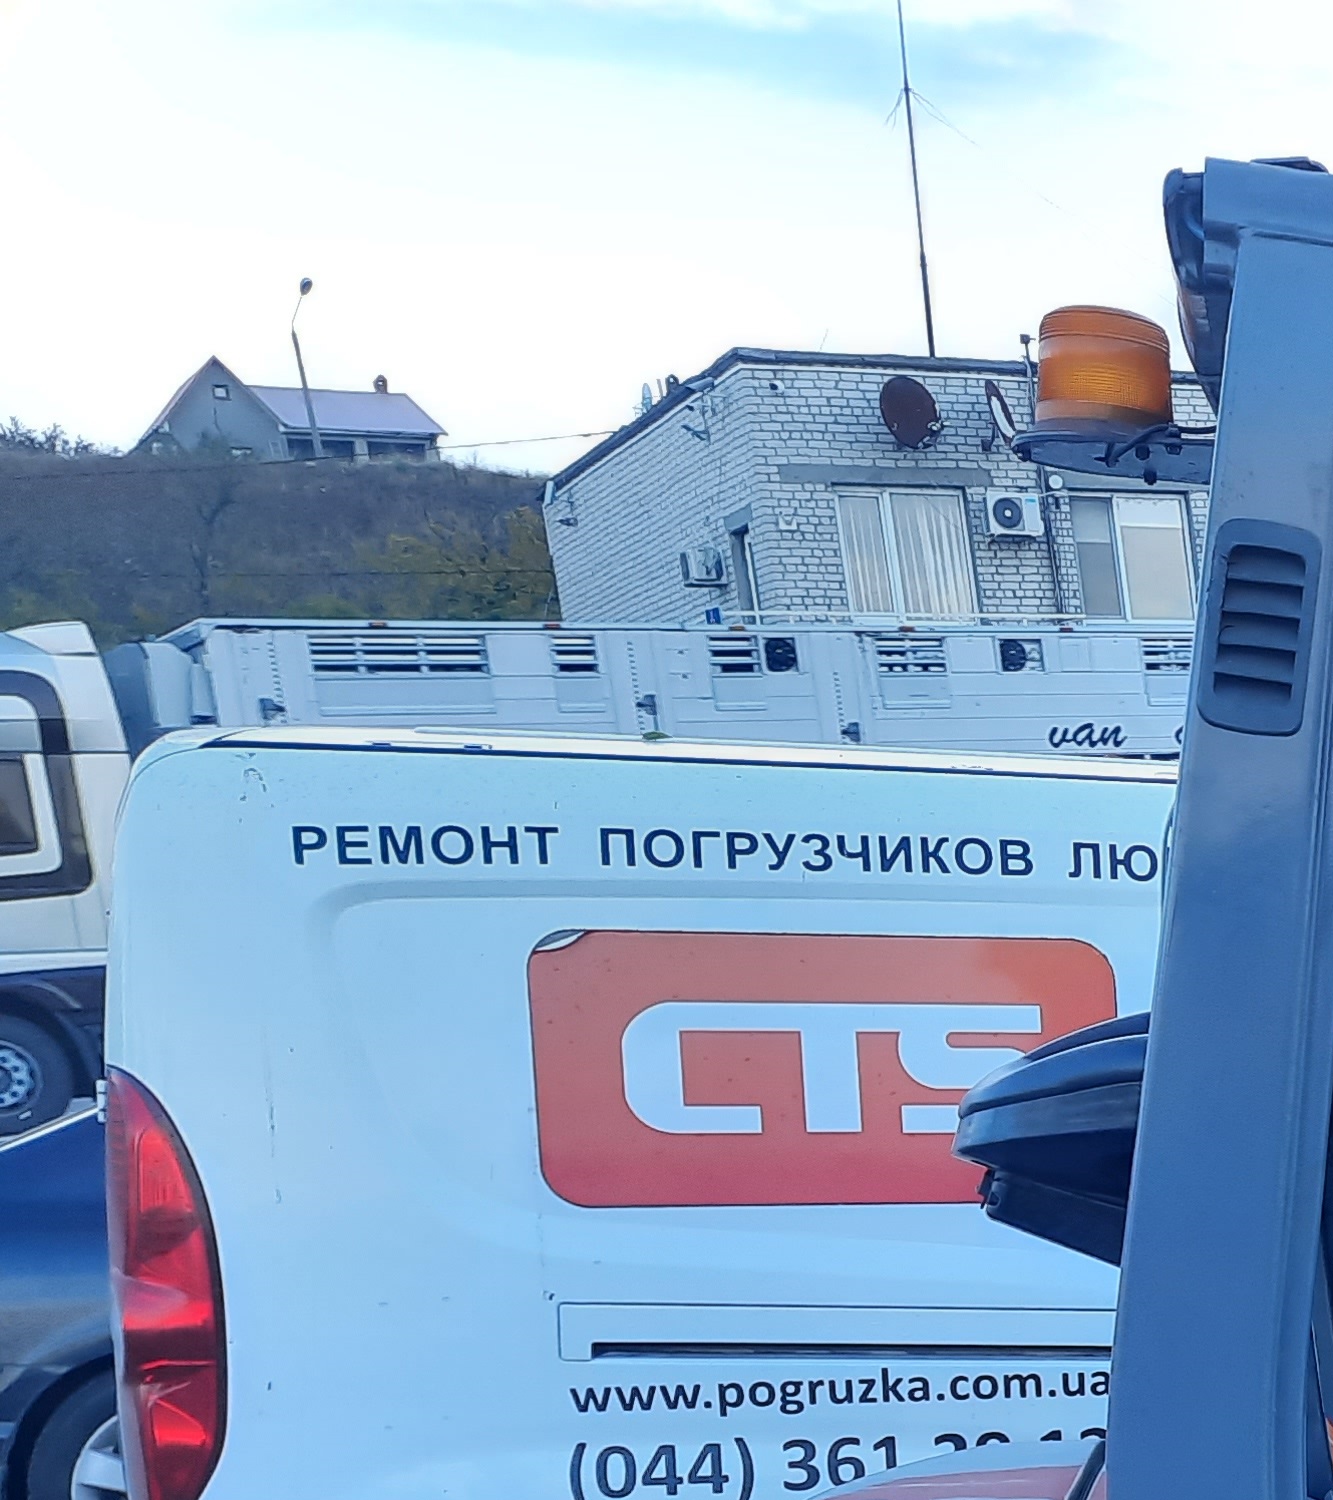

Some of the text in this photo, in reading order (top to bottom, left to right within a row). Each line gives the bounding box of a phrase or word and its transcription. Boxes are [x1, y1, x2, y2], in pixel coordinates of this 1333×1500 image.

[1047, 722, 1129, 749] van
[292, 823, 559, 867] РЕМОНТ
[599, 827, 1034, 877] ПОГРУЗЧИКОВ
[621, 1000, 1041, 1134] CTS
[569, 1368, 1109, 1417] www.pogruzka.com.ua
[781, 1435, 899, 1491] 361
